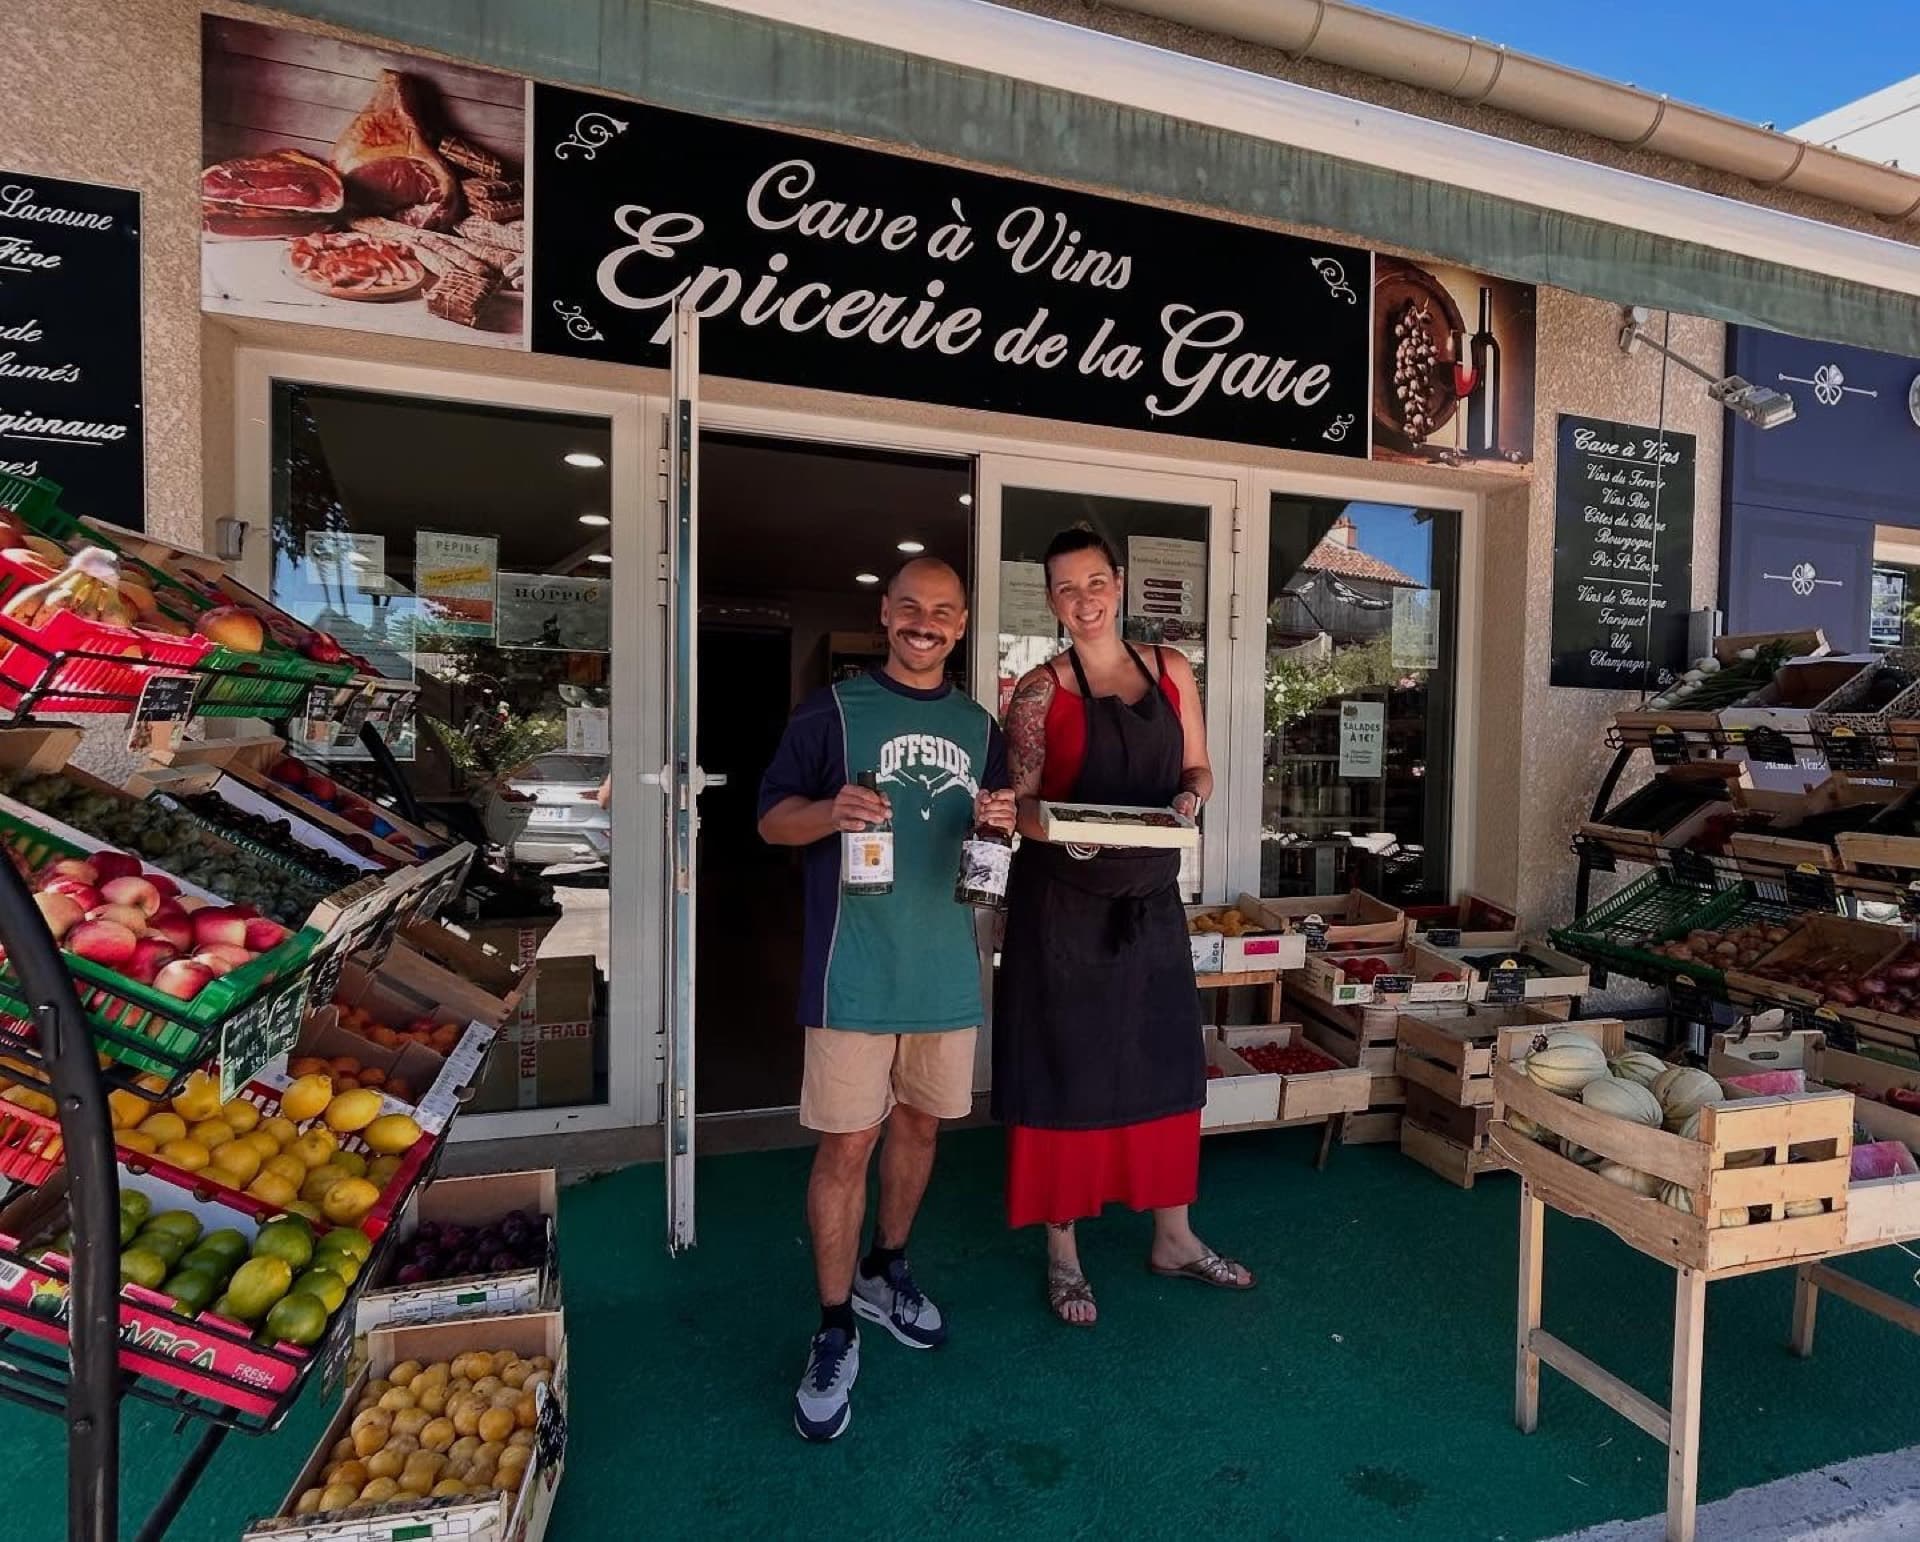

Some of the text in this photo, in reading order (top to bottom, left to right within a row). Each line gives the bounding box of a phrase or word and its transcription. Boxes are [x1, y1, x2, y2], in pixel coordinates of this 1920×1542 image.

[0, 185, 113, 230] Lacaune
[746, 160, 1133, 290] Cave à Vins
[596, 204, 1332, 417] Epicerie de la Gare
[0, 408, 127, 440] gionaux
[1574, 428, 1680, 464] Cave à Vins
[1587, 463, 1610, 482] Vins
[1612, 469, 1626, 485] du
[1602, 487, 1651, 509] Vins Bio
[1584, 505, 1613, 525] Côtes
[1614, 512, 1629, 527] du
[1590, 550, 1612, 568] Pic
[1577, 585, 1601, 603] Vins
[1603, 589, 1616, 604] de
[1610, 632, 1633, 654] Uby
[1343, 722, 1380, 732] SALADES
[880, 733, 972, 778] OFFSIDE
[234, 1363, 276, 1386] FRESH
